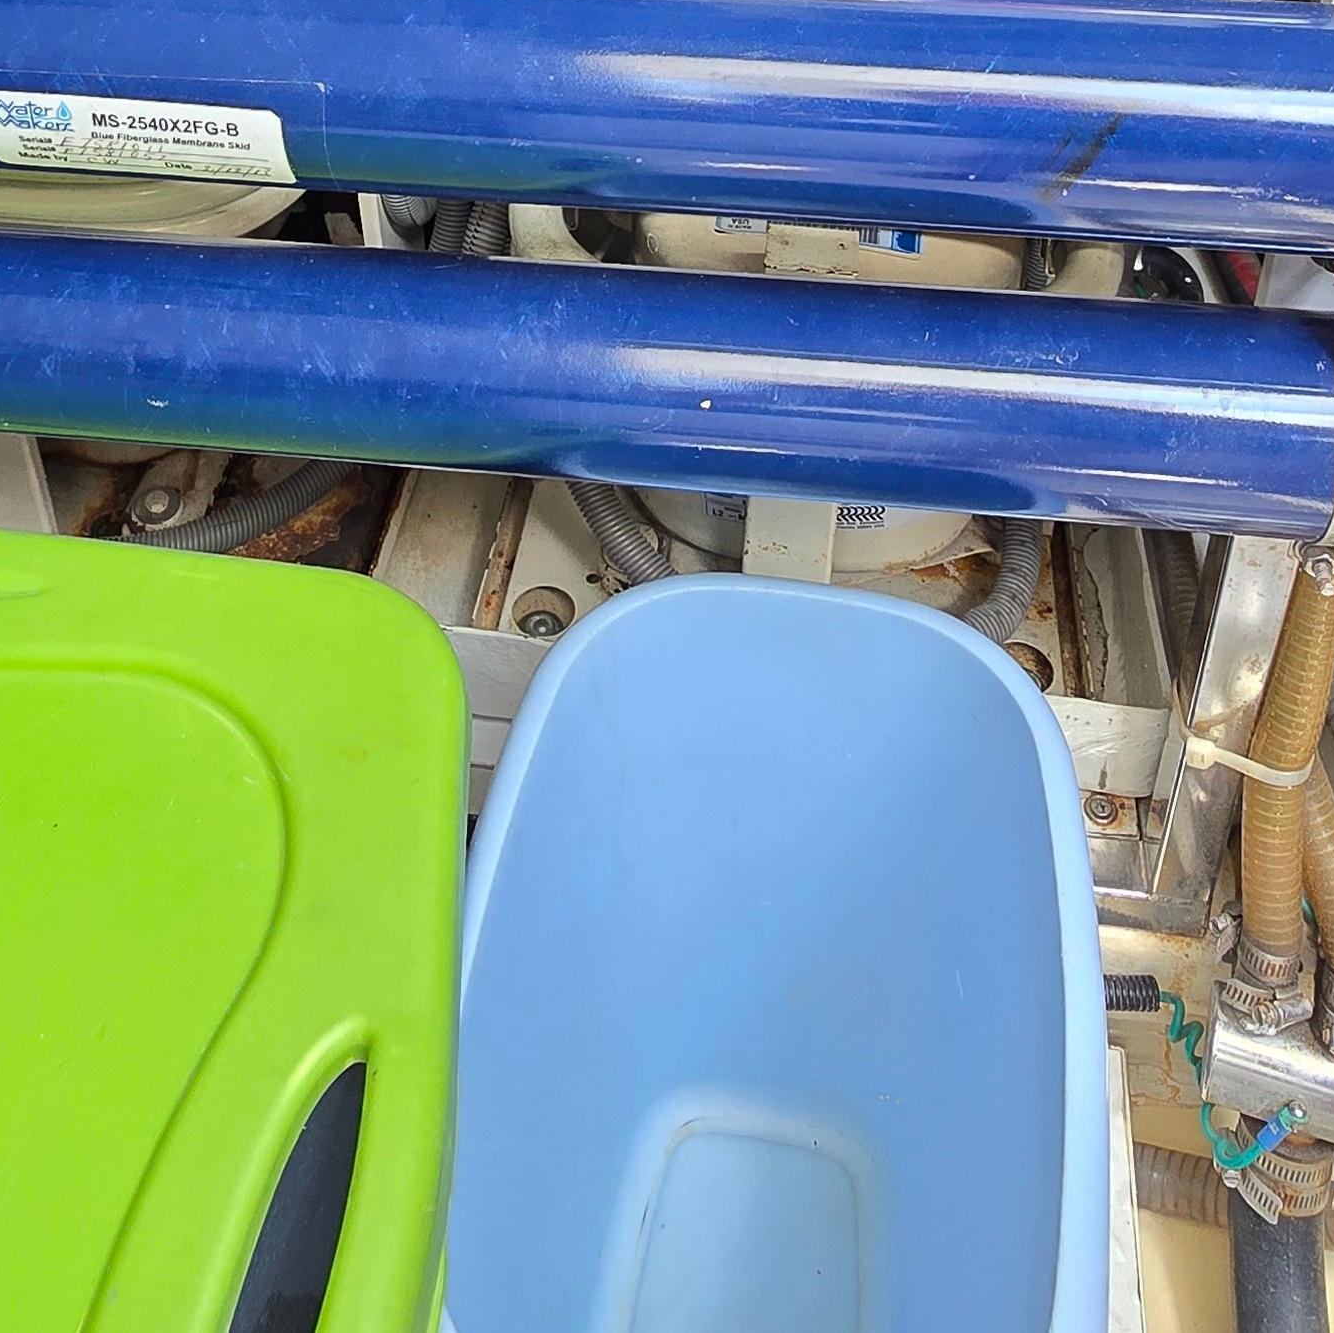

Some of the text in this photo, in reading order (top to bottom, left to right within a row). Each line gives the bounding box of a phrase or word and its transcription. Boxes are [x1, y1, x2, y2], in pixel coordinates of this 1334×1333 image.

[92, 113, 239, 136] MS-2540X2FG-B
[91, 132, 251, 150] Blue Fiberglass Membrane Skid
